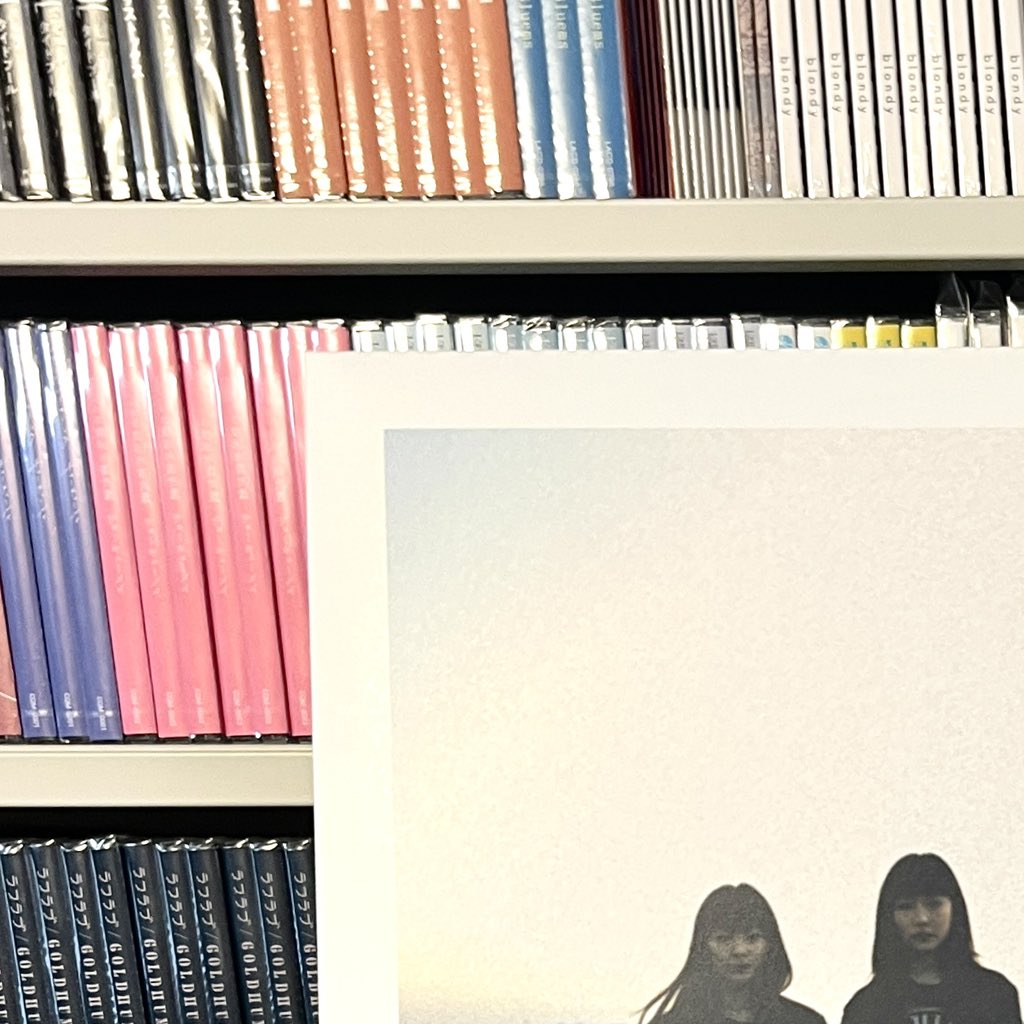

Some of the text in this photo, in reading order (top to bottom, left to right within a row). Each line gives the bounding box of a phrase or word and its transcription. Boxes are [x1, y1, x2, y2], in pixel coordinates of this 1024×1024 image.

[780, 56, 793, 116] blondy
[807, 57, 820, 118] blondy
[831, 52, 844, 113] blondy
[856, 53, 869, 114] blondy
[882, 54, 896, 114] blondy
[906, 53, 920, 114] blondy
[932, 54, 945, 115] blondy
[956, 53, 969, 114] blondy
[983, 54, 997, 115] blondy
[1010, 54, 1023, 115] blondy
